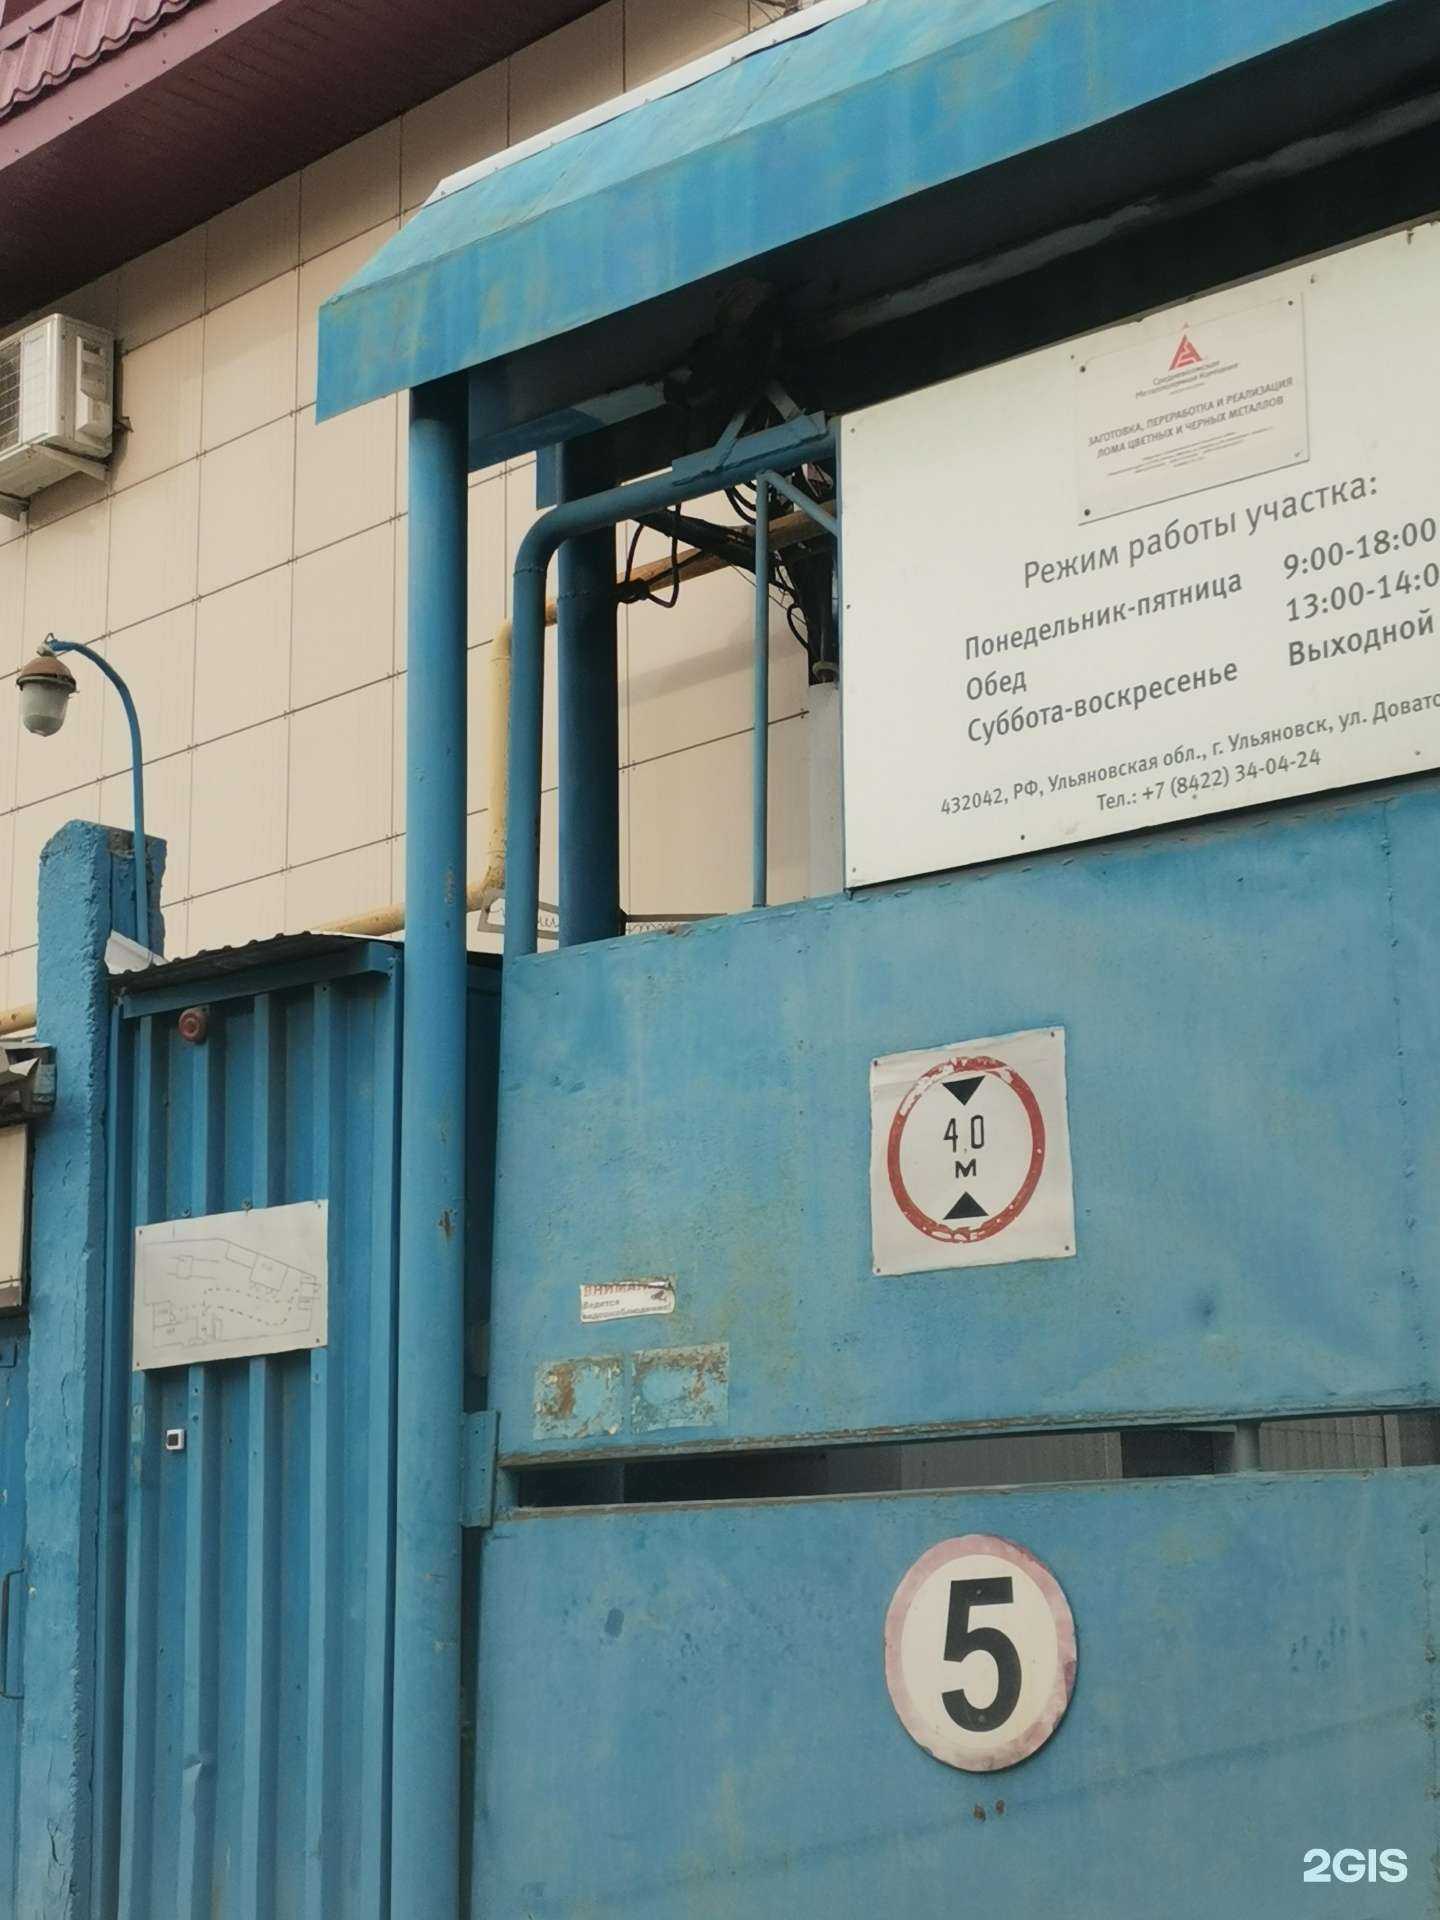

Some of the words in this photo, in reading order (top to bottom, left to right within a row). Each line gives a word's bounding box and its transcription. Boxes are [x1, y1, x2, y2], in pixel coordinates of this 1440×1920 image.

[1096, 442, 1126, 459] ЛОМА
[1127, 428, 1174, 450] ЦВЕТНЫХ
[1175, 424, 1183, 435] И
[1229, 395, 1284, 419] МЕТАЛЛОВ
[1146, 401, 1215, 428] ПЕРЕРАБОТКА
[1217, 398, 1224, 408] И
[1225, 376, 1293, 405] РЕАЛИЗАЦИЯ
[1024, 545, 1119, 588] Режим
[1129, 512, 1236, 568] работы
[1245, 476, 1377, 536] участка:
[965, 572, 1242, 661] Понедельник-пятница
[1283, 517, 1437, 580] 9:00-18:00
[966, 670, 1027, 701] Обед
[967, 661, 1239, 746] Суббота-воскресенье
[1288, 608, 1434, 667] Выходной
[940, 787, 1009, 815] 432042,
[1013, 778, 1044, 800] РФ,
[1047, 755, 1159, 793] Ульяновская
[1162, 744, 1207, 767] обл.,
[1211, 741, 1224, 757] г.
[1227, 716, 1334, 753] Ульяновск,
[1338, 711, 1368, 733] ул.
[1096, 793, 1137, 811] Тел.:
[1141, 781, 1165, 801] +7
[1170, 766, 1230, 799] (8422)
[1234, 749, 1322, 783] 34-04-24
[941, 1575, 1023, 1733] 5
